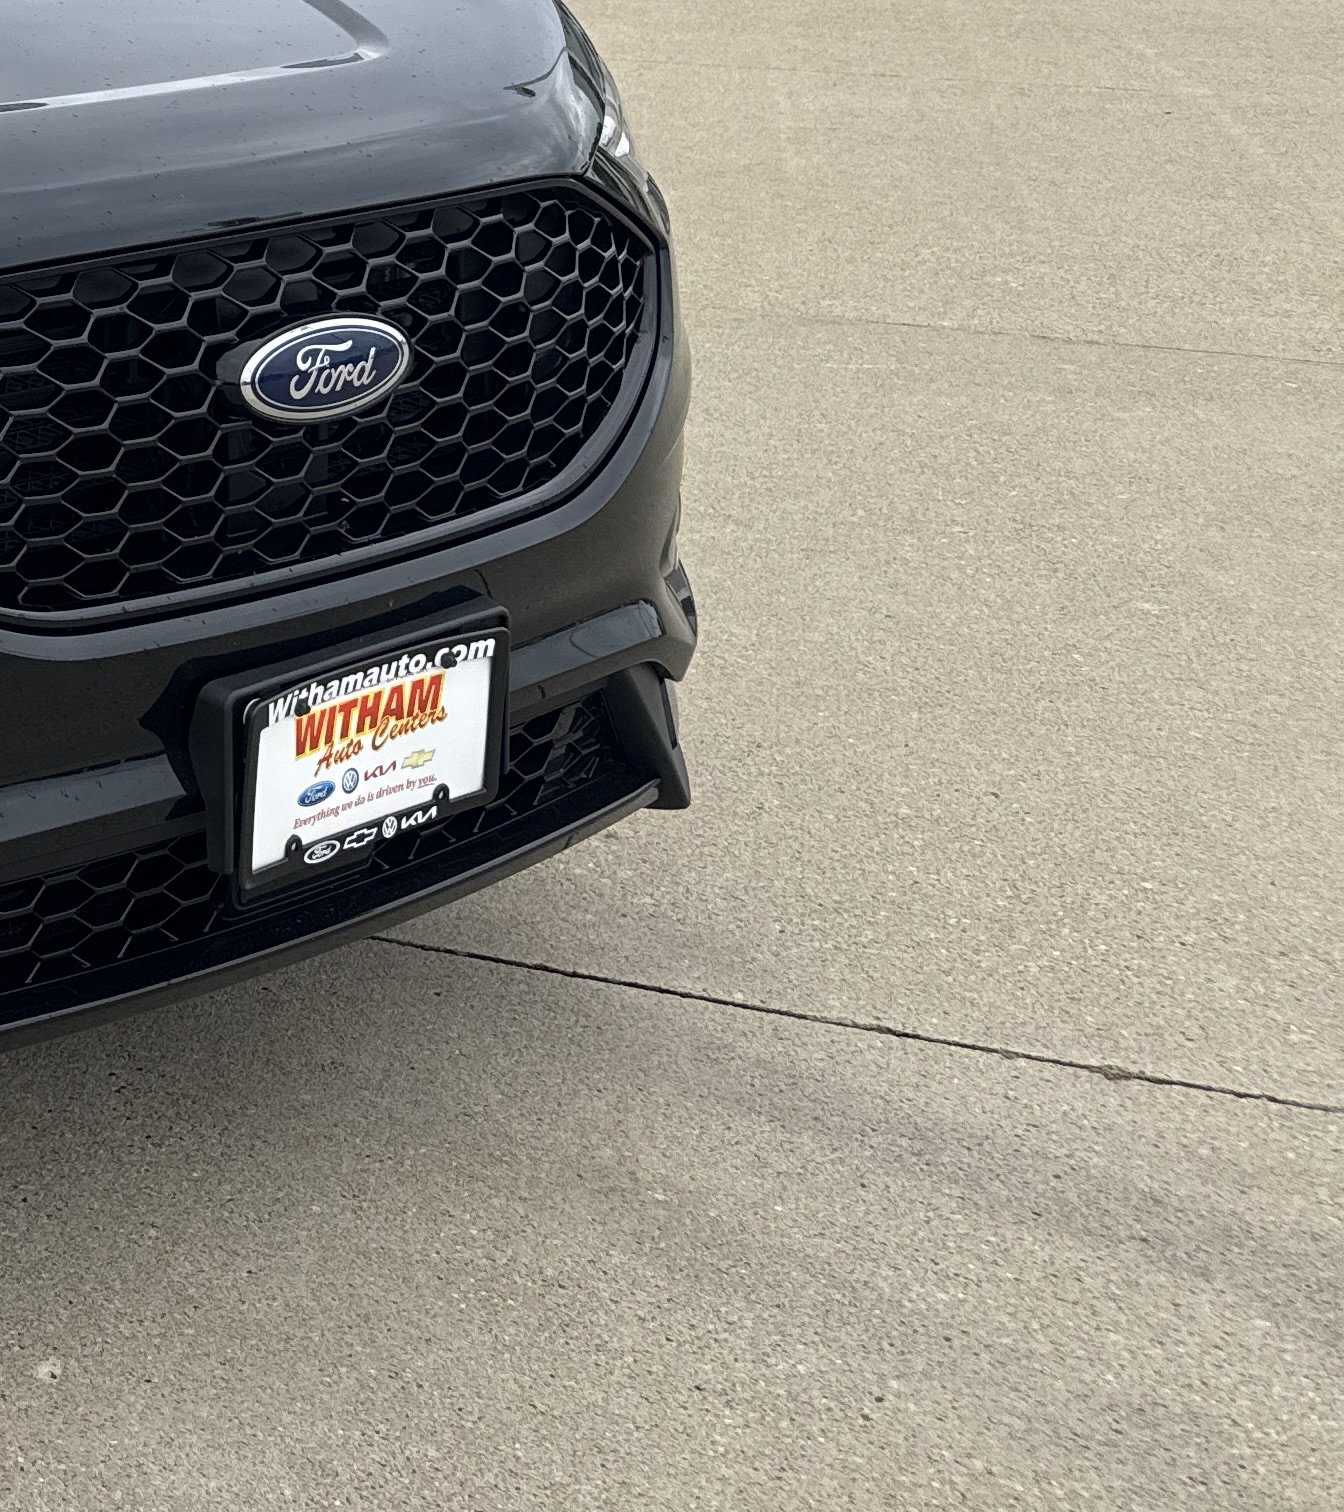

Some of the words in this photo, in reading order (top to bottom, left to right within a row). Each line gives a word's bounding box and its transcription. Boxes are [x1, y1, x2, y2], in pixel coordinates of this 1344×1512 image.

[289, 339, 377, 400] Ford
[295, 673, 444, 758] WITHAM
[314, 738, 364, 777] Auto
[372, 705, 448, 750] Centers
[293, 805, 340, 830] Everything
[341, 800, 353, 812] we
[354, 794, 365, 805] do
[367, 791, 374, 801] is
[375, 781, 404, 799] driven
[406, 778, 417, 791] by
